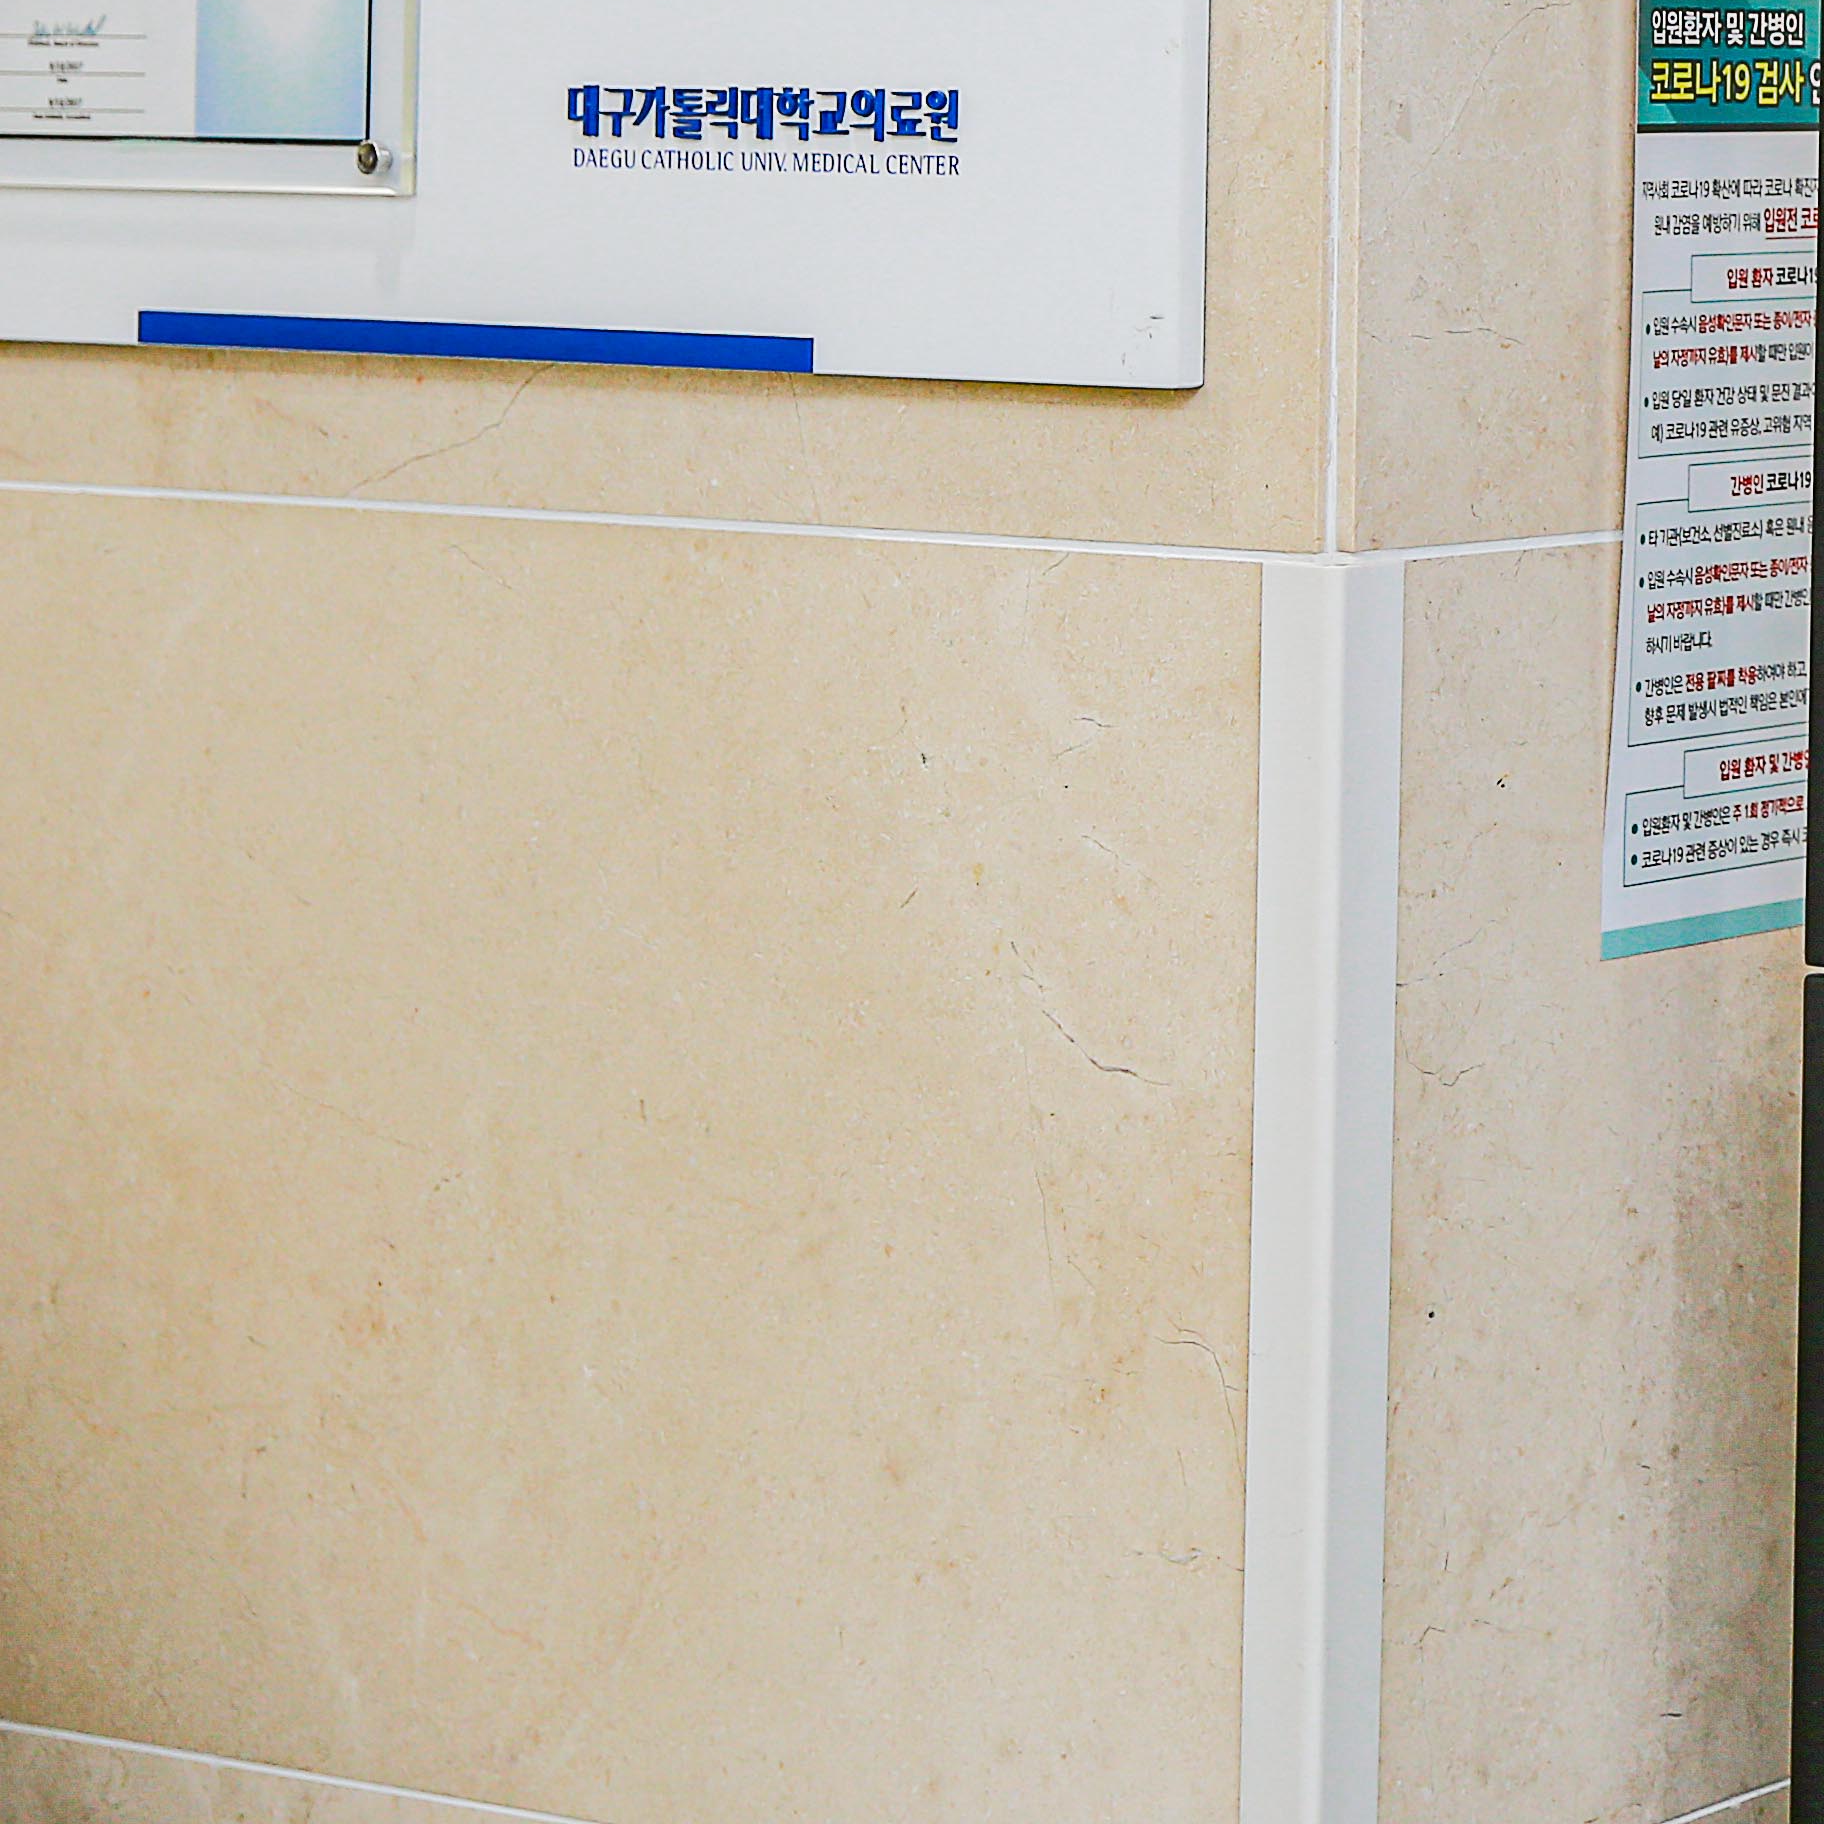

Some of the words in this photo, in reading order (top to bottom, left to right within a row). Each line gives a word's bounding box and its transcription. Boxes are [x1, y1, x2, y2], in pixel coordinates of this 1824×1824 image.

[1652, 10, 1722, 45] 입원환자
[1726, 11, 1744, 45] 및
[1748, 11, 1804, 46] 간병인
[1651, 60, 1750, 104] 코로나19
[1755, 61, 1805, 105] 검사
[567, 84, 959, 144] 대구가톨릭대학교의료원
[572, 146, 637, 170] DAEGU
[641, 148, 735, 172] CATHOLIC
[741, 149, 788, 173] UNIV.
[793, 151, 881, 175] MEDICAL
[885, 154, 960, 176] CENTER
[1730, 474, 1764, 496] 간병인
[1766, 471, 1811, 491] 코로나19
